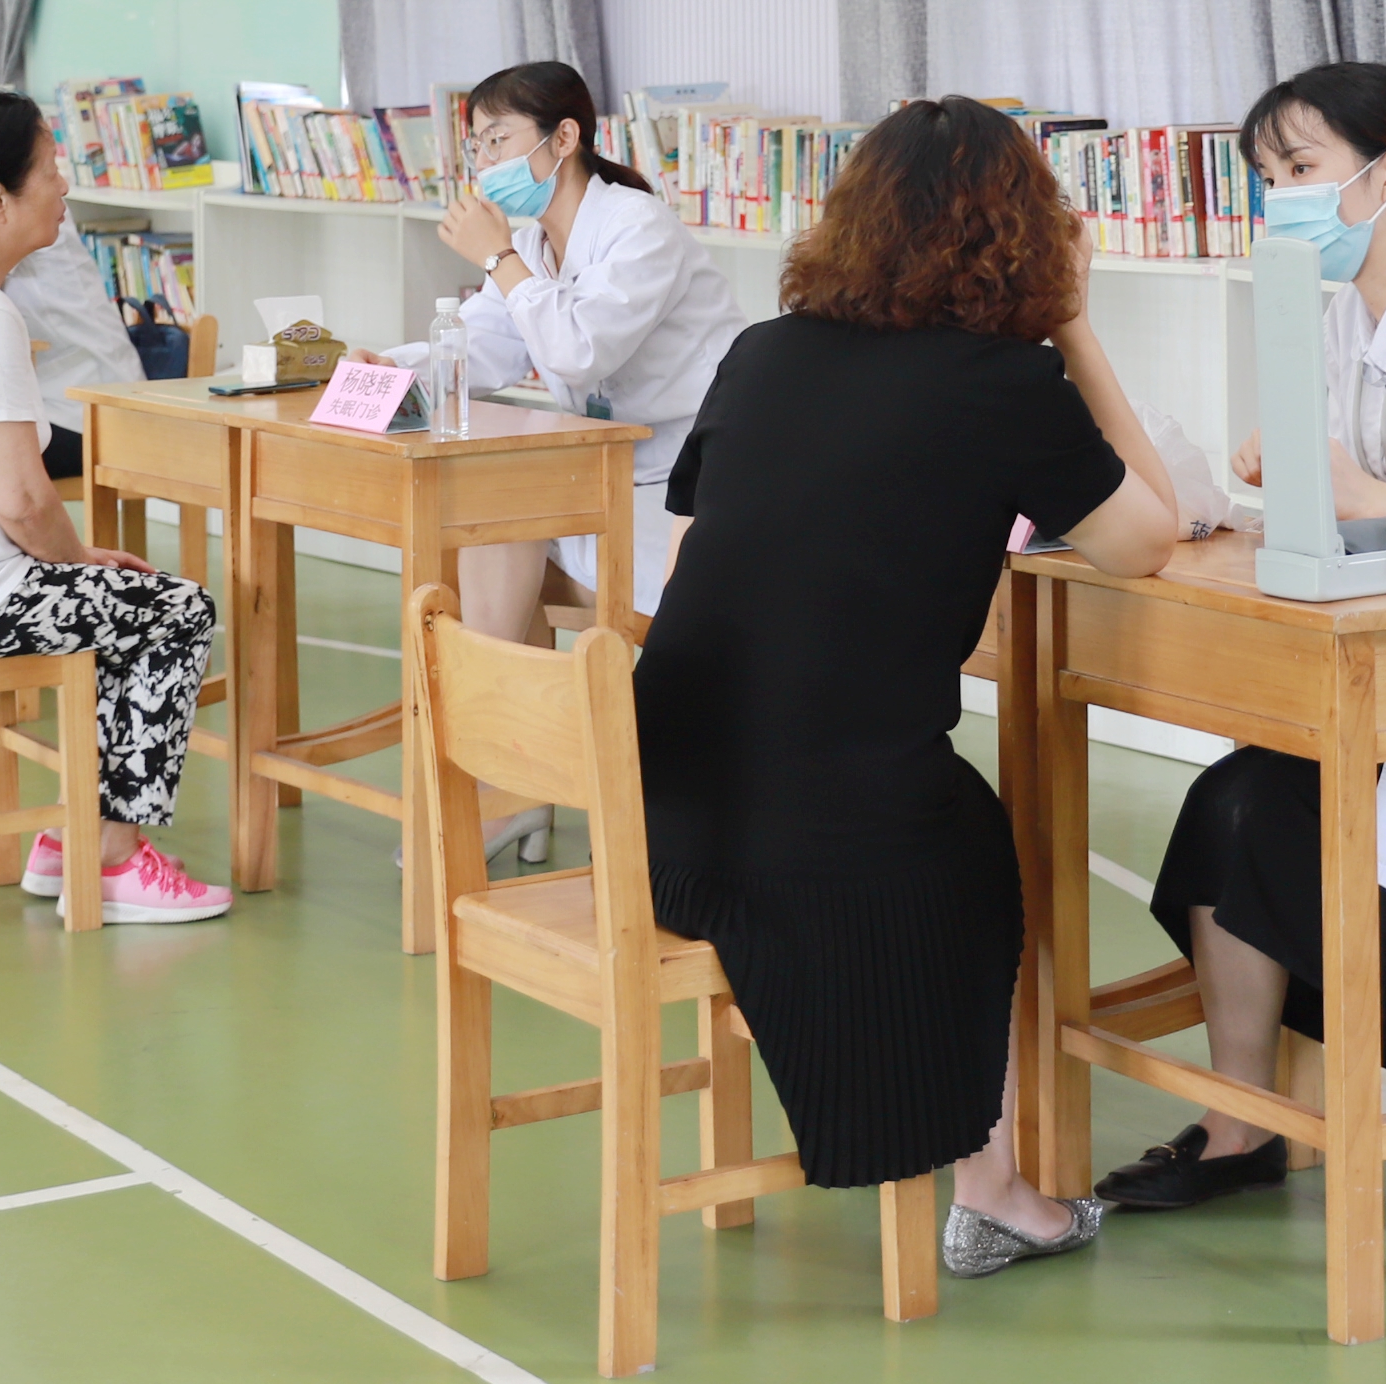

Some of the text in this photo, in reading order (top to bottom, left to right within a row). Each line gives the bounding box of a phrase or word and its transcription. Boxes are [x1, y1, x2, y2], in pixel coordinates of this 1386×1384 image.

[341, 368, 397, 399] 杨晓辉
[327, 399, 381, 419] 失眠门诊
